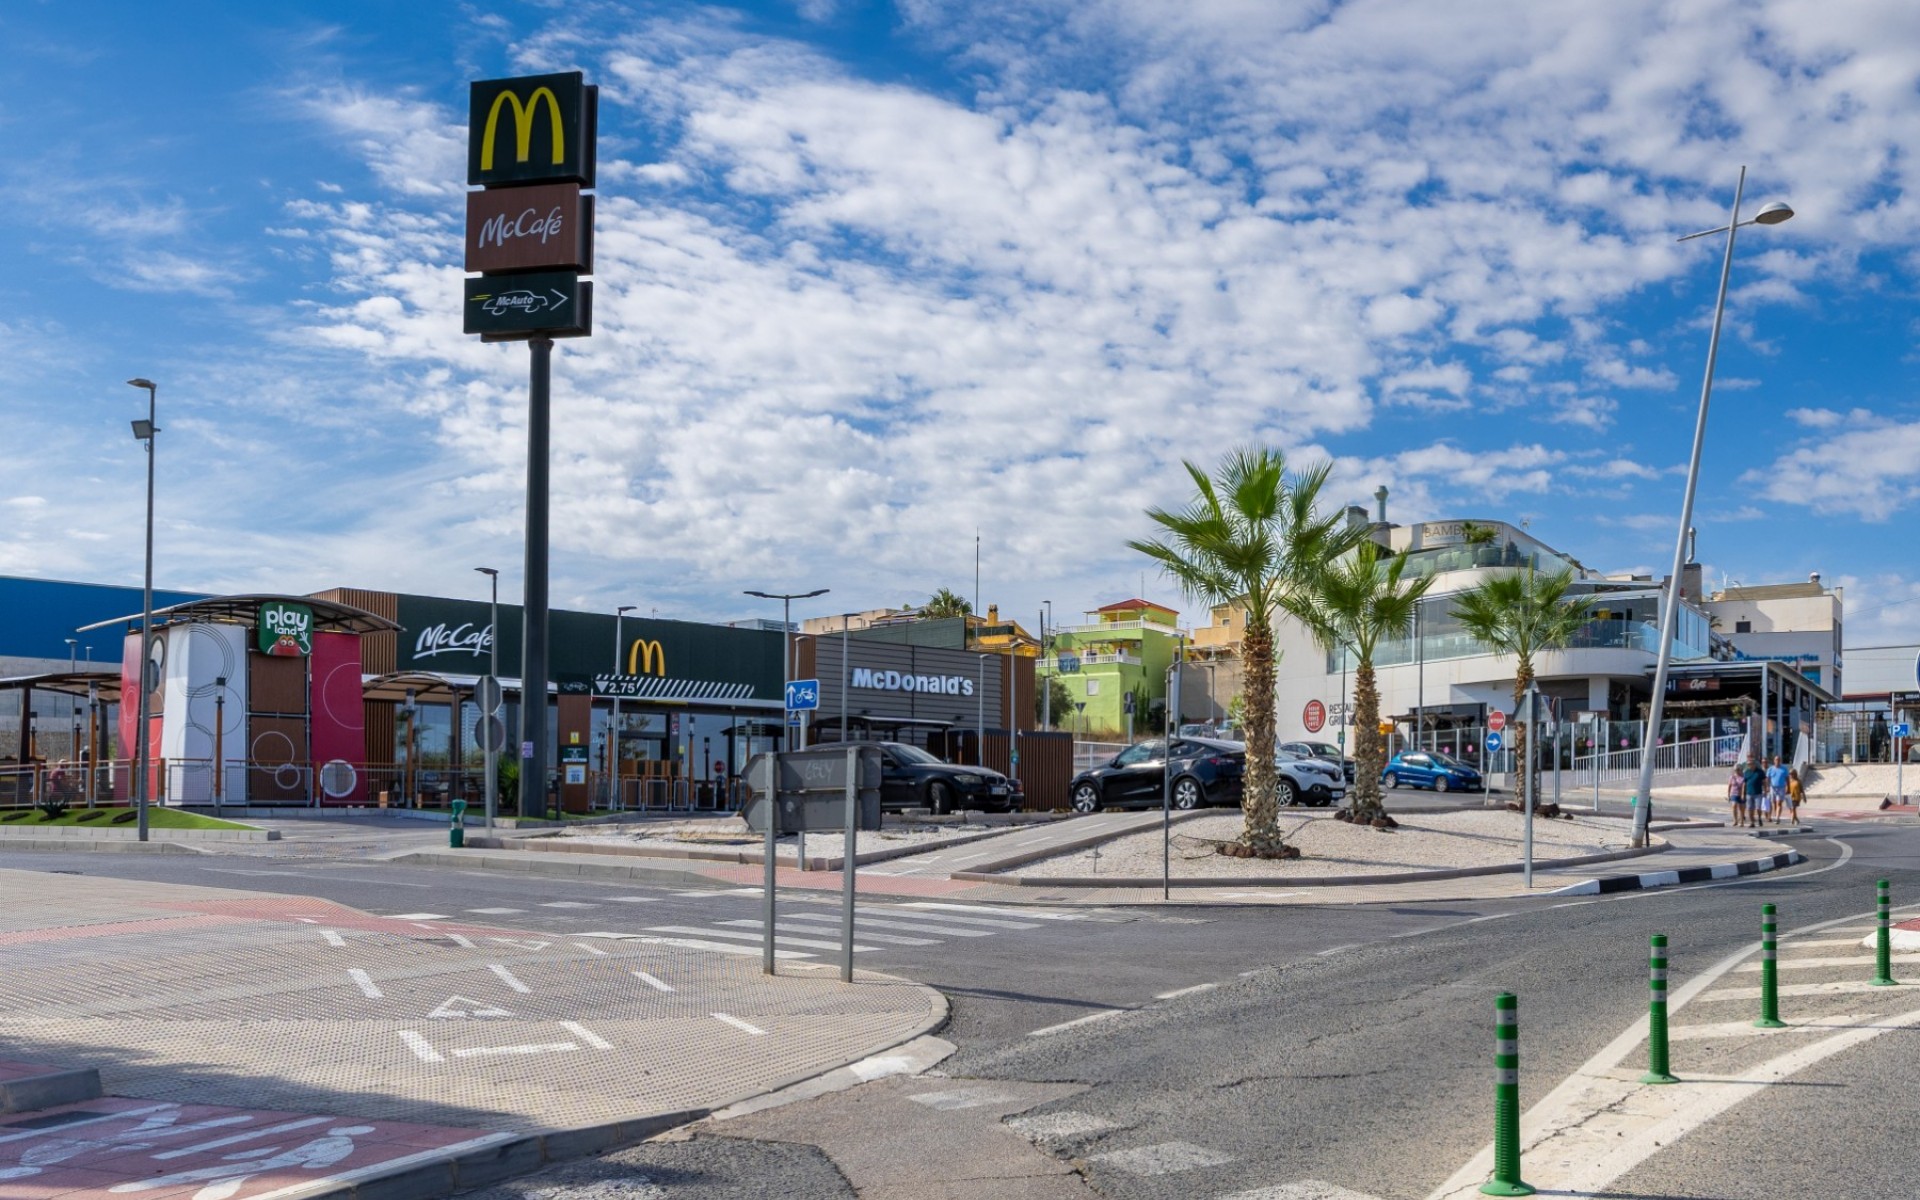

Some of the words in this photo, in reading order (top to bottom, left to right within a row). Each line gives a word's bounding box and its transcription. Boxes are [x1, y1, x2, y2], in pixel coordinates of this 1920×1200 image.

[479, 206, 562, 249] McCafé
[496, 296, 534, 306] McAuto
[265, 605, 308, 632] play
[275, 624, 297, 635] land
[851, 667, 974, 696] McDonald's
[609, 682, 635, 694] 2.75
[1892, 725, 1901, 737] P
